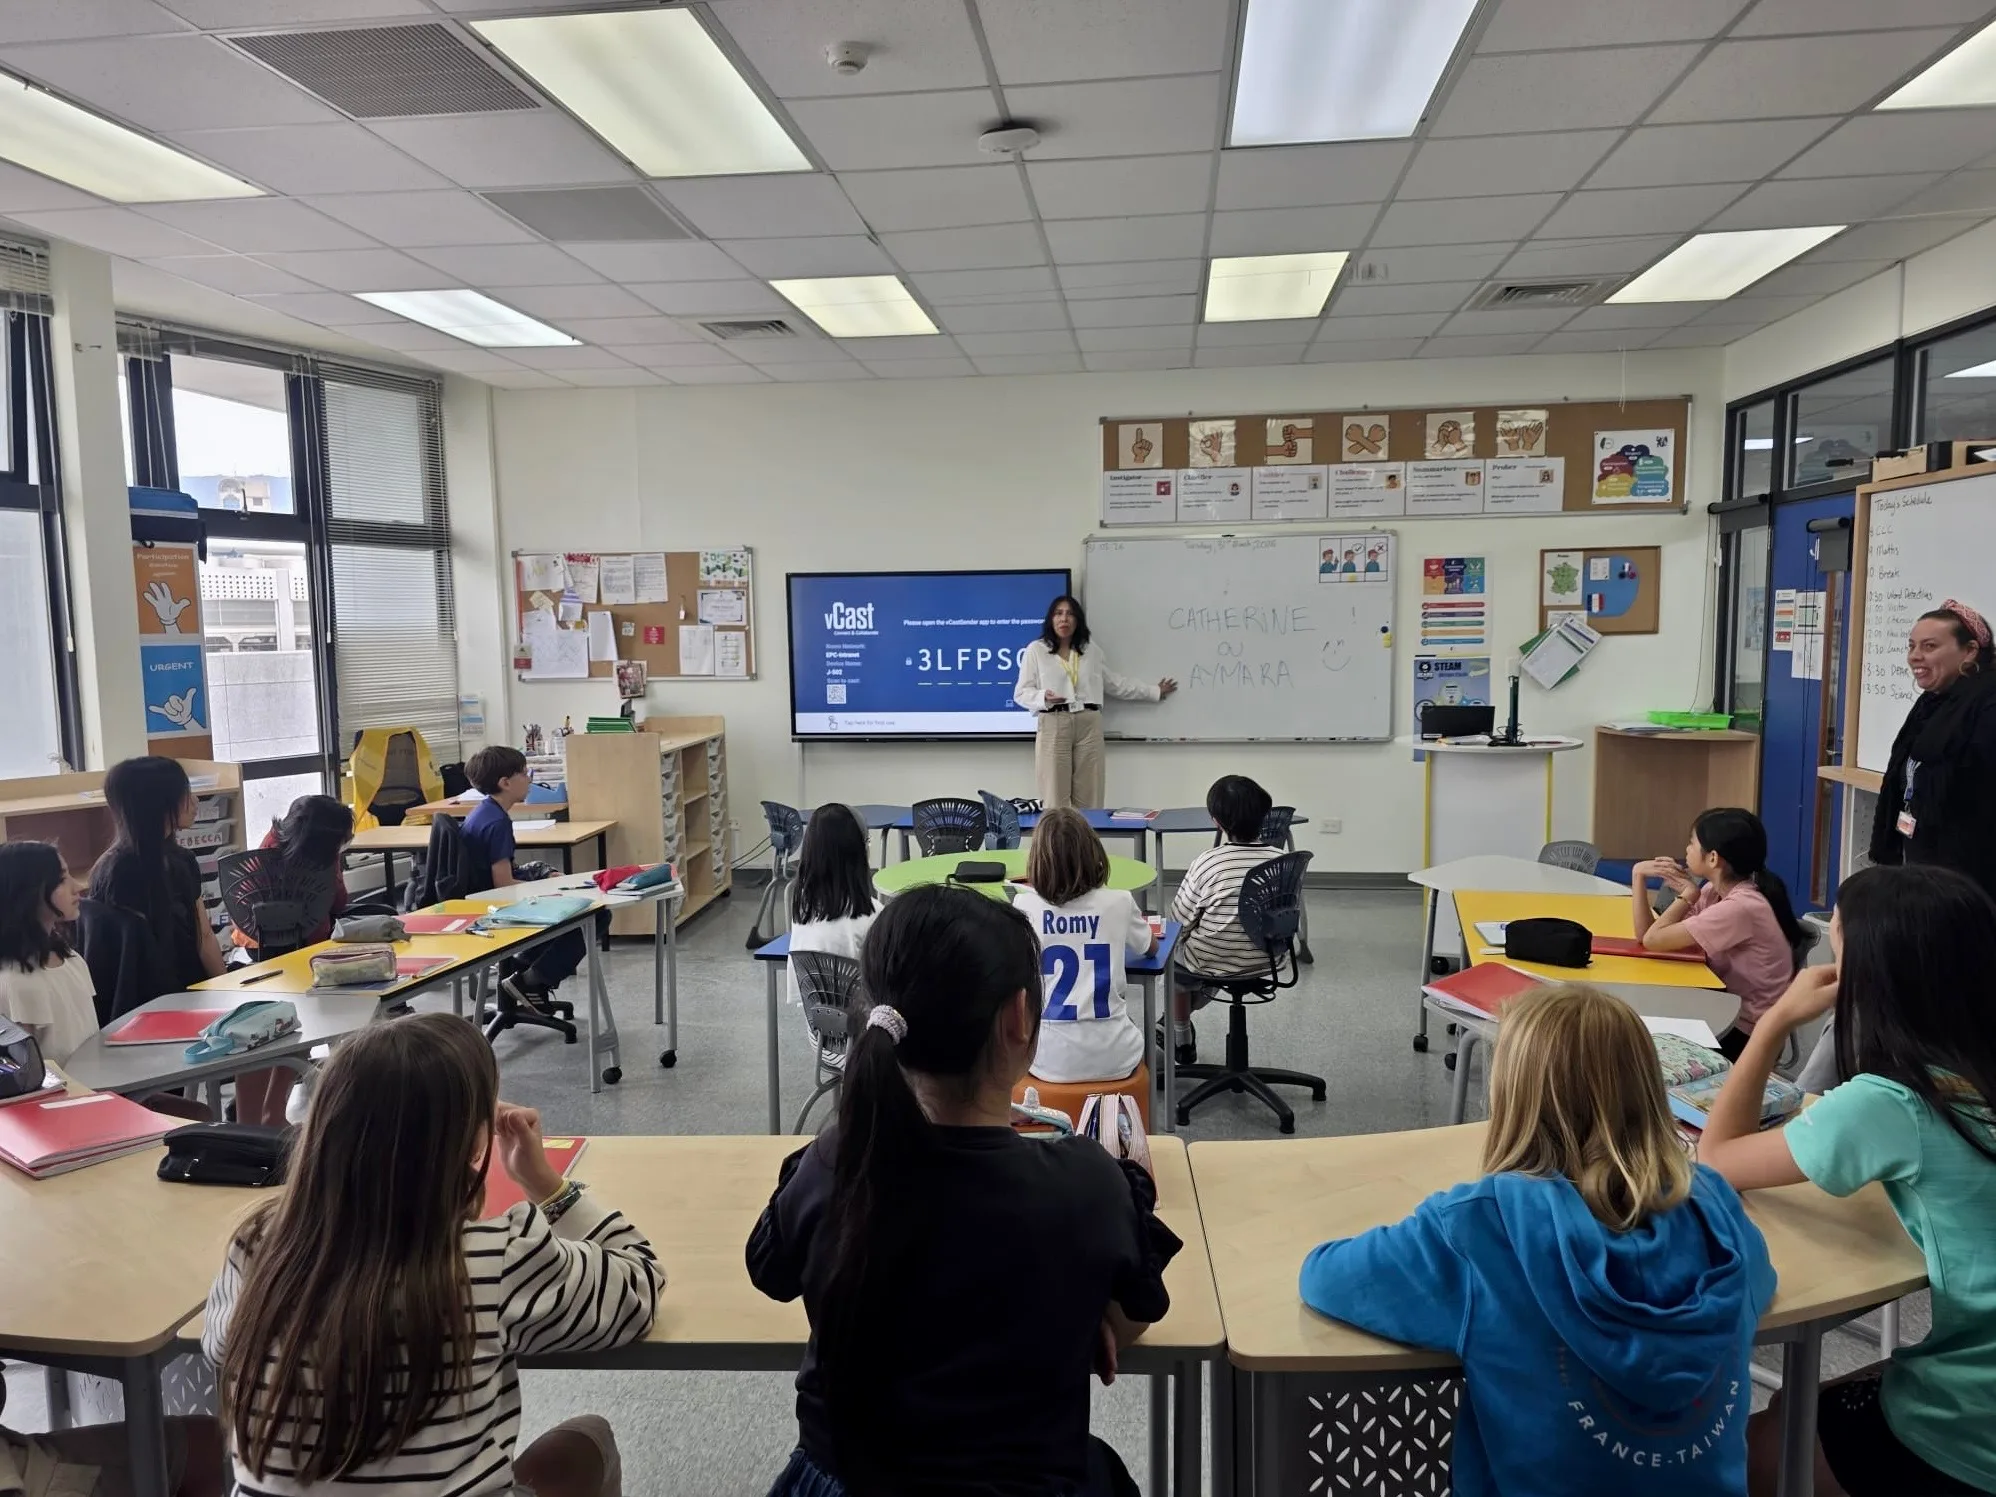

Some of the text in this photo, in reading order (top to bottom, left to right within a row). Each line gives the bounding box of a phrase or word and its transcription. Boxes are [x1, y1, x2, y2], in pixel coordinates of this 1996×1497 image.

[824, 601, 875, 630] vCast
[149, 661, 195, 672] URGENT
[1190, 660, 1295, 690] AYMARA
[1434, 661, 1462, 671] STEAM
[177, 833, 223, 847] EBECCA
[1042, 909, 1100, 940] Romy
[1040, 943, 1111, 1021] 21
[1568, 1380, 1740, 1468] FRANCE-TAIWAN
